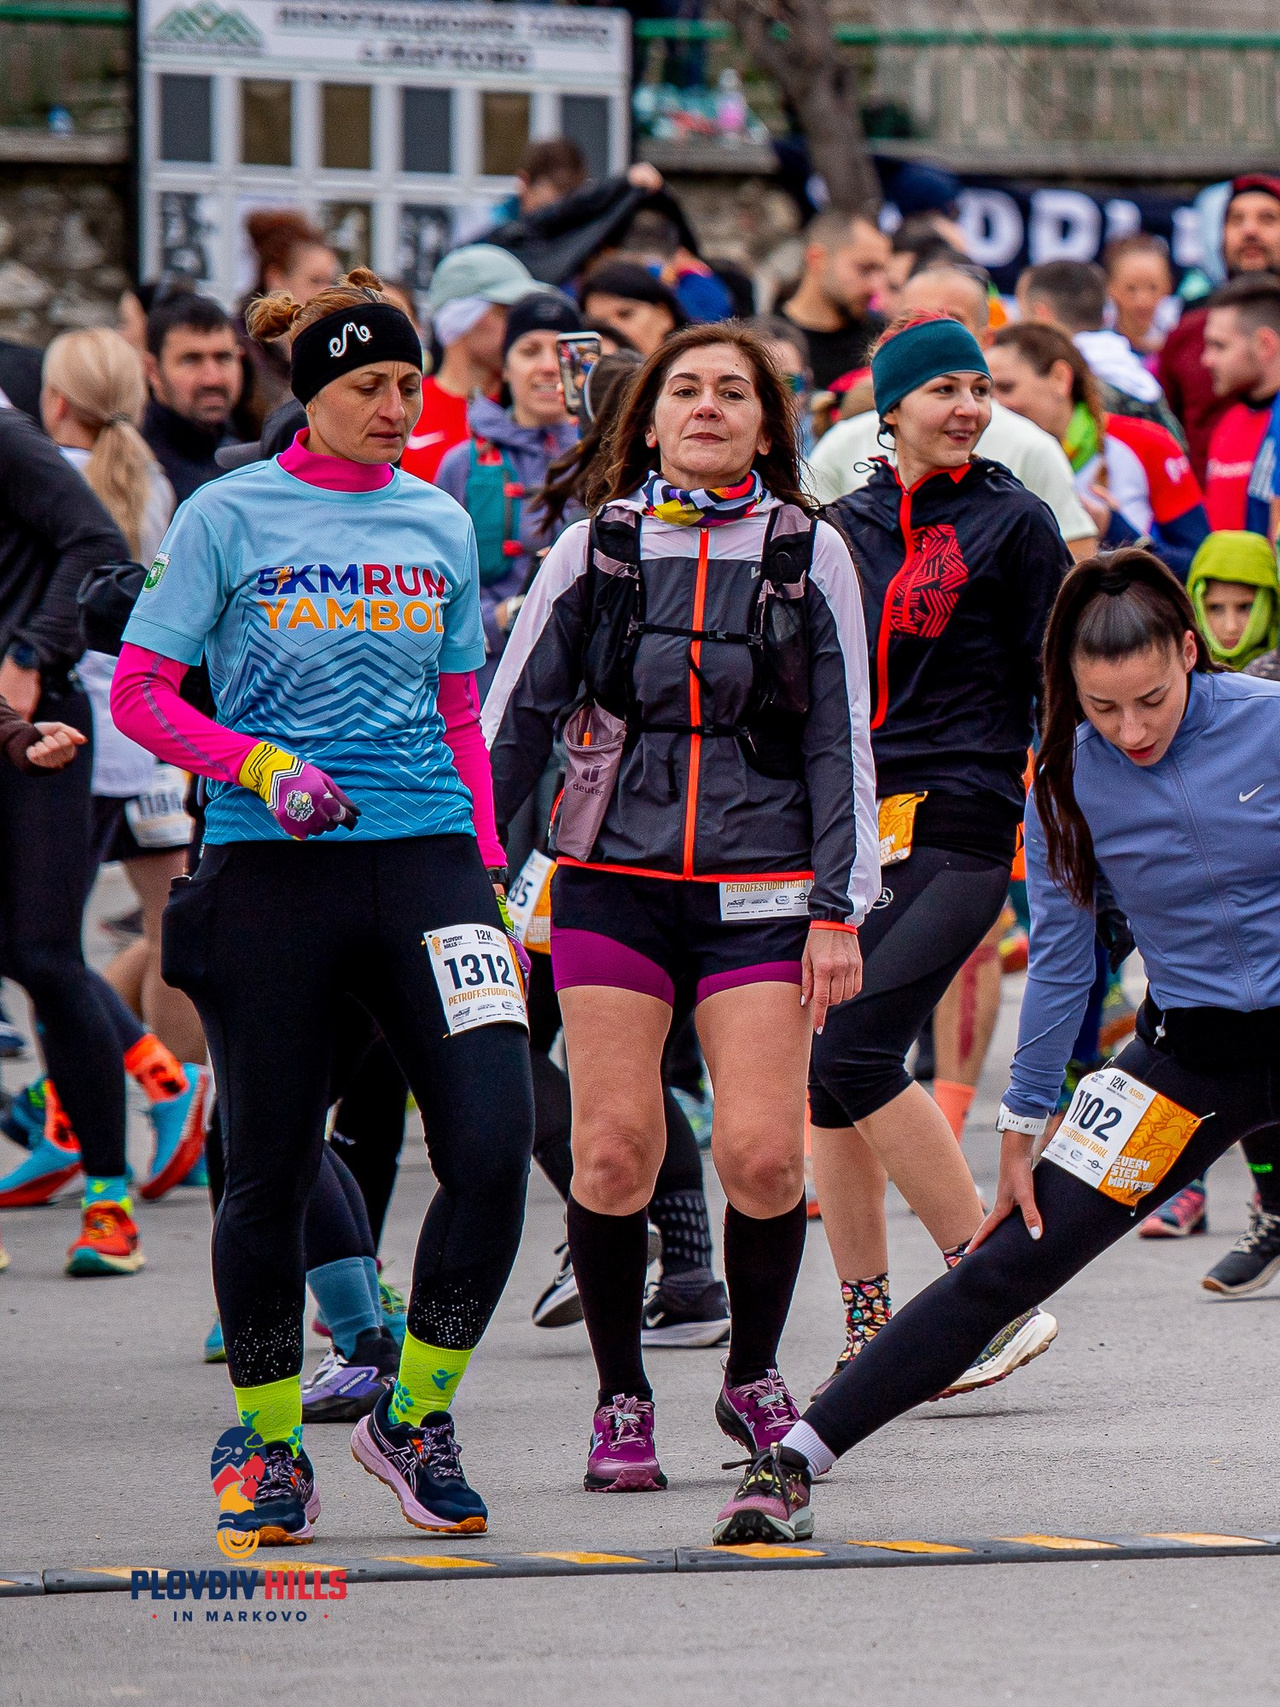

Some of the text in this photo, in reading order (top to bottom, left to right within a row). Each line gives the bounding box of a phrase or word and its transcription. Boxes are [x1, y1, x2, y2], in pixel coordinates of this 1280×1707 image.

[258, 597, 445, 634] YAMBOL
[572, 782, 604, 797] deuter
[475, 929, 493, 941] 12K
[444, 954, 515, 990] 1312
[1109, 1075, 1128, 1092] 12K
[1069, 1089, 1123, 1142] 1102
[1088, 1141, 1109, 1158] TRAIL
[1114, 1155, 1150, 1171] EVERY
[1110, 1165, 1140, 1179] STEP
